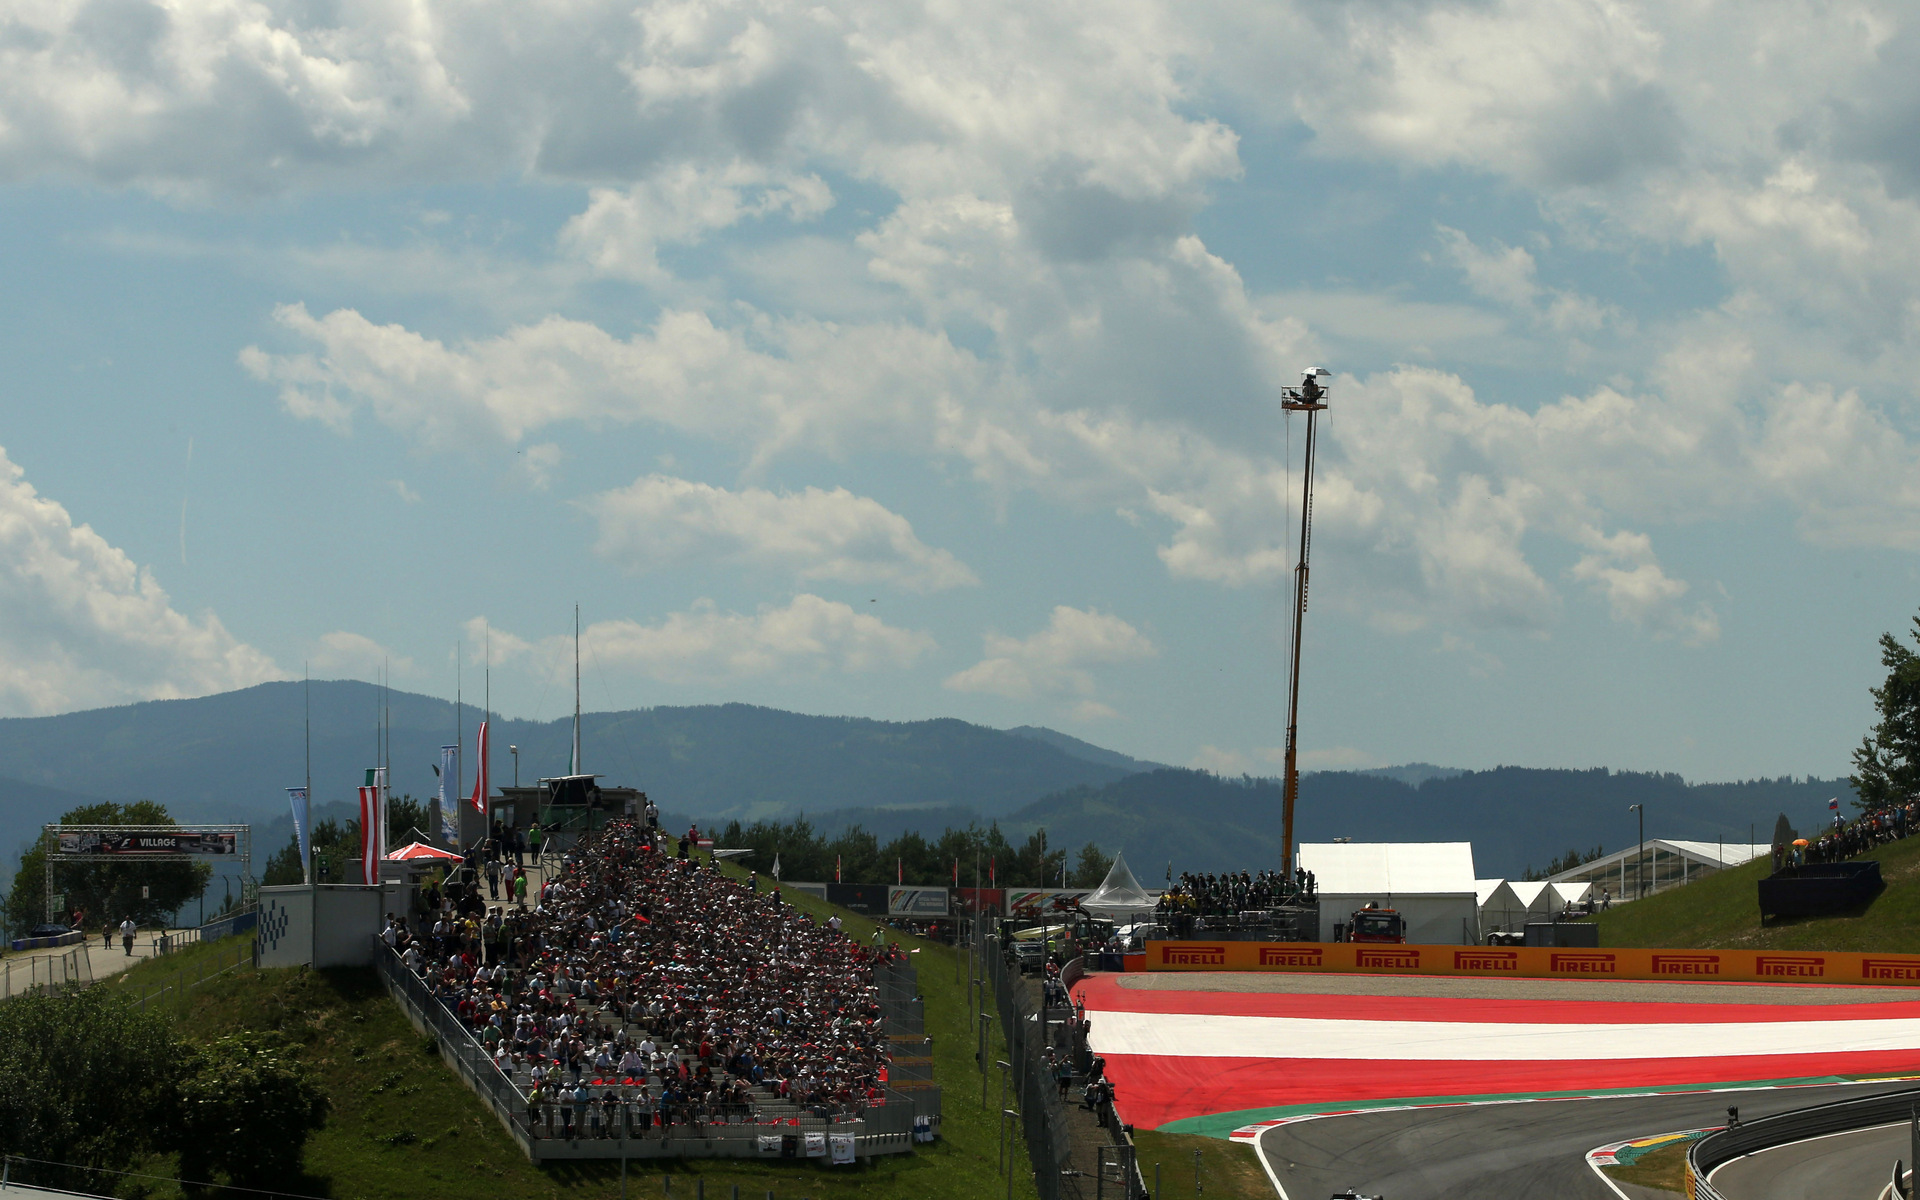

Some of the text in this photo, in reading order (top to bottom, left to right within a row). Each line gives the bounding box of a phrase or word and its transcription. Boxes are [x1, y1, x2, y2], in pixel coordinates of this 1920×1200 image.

[139, 838, 176, 847] VILLAGE
[1162, 946, 1225, 965] PIRELLI
[1259, 947, 1323, 966] PIRELLI
[1356, 949, 1420, 968] PIRELLI
[1454, 951, 1518, 970] PIRELLI
[1550, 953, 1616, 973] PIRELLI
[1652, 955, 1720, 974] PIRELLI
[1756, 956, 1825, 977] PIRELLI
